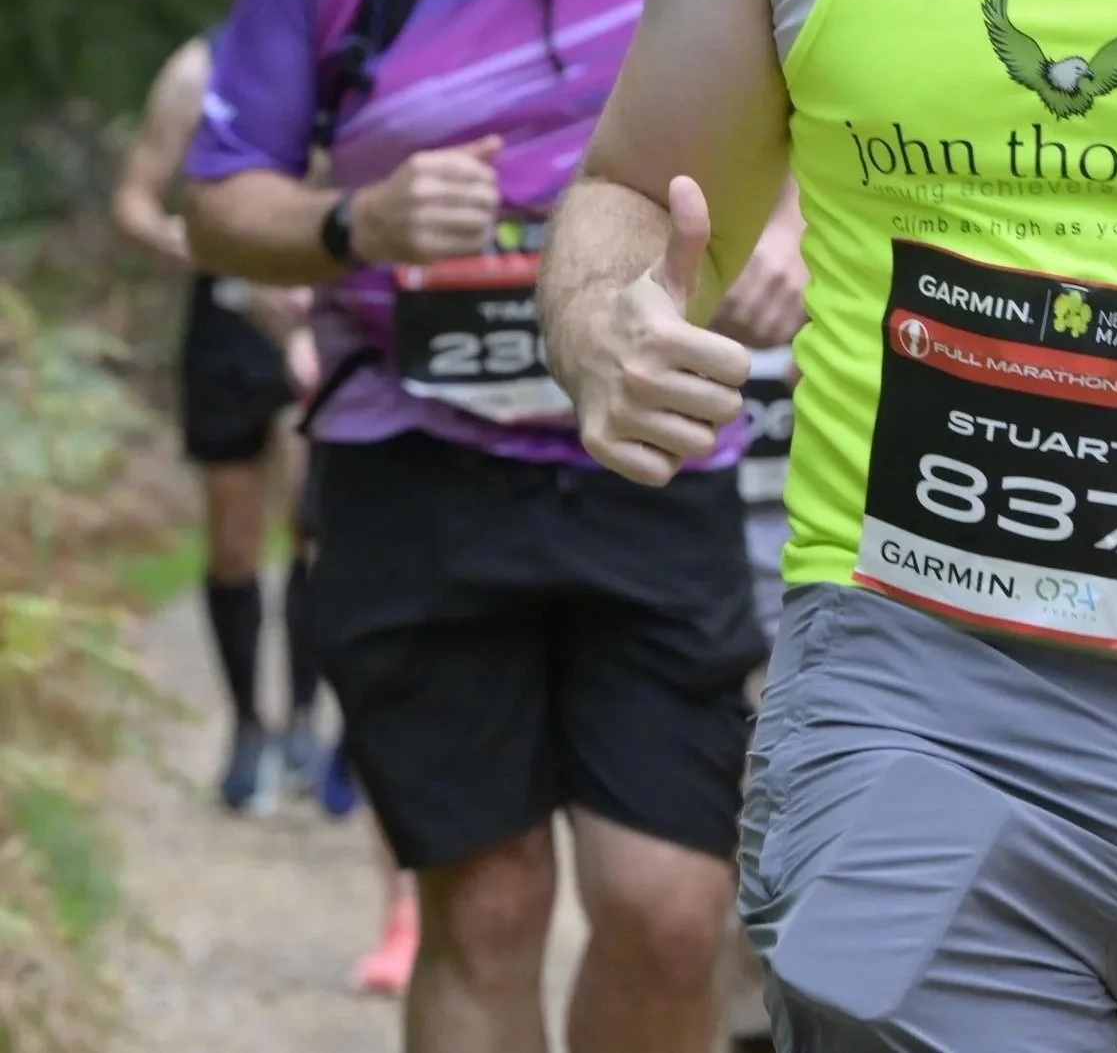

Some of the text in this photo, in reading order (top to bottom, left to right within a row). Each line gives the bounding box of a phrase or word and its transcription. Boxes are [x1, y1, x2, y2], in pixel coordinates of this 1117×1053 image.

[845, 120, 981, 187] john
[990, 218, 1041, 240] high
[1055, 221, 1081, 236] as
[918, 274, 1032, 325] GARMIN
[427, 331, 547, 376] 23
[934, 342, 983, 367] FULL
[881, 540, 1016, 600] GARMIN
